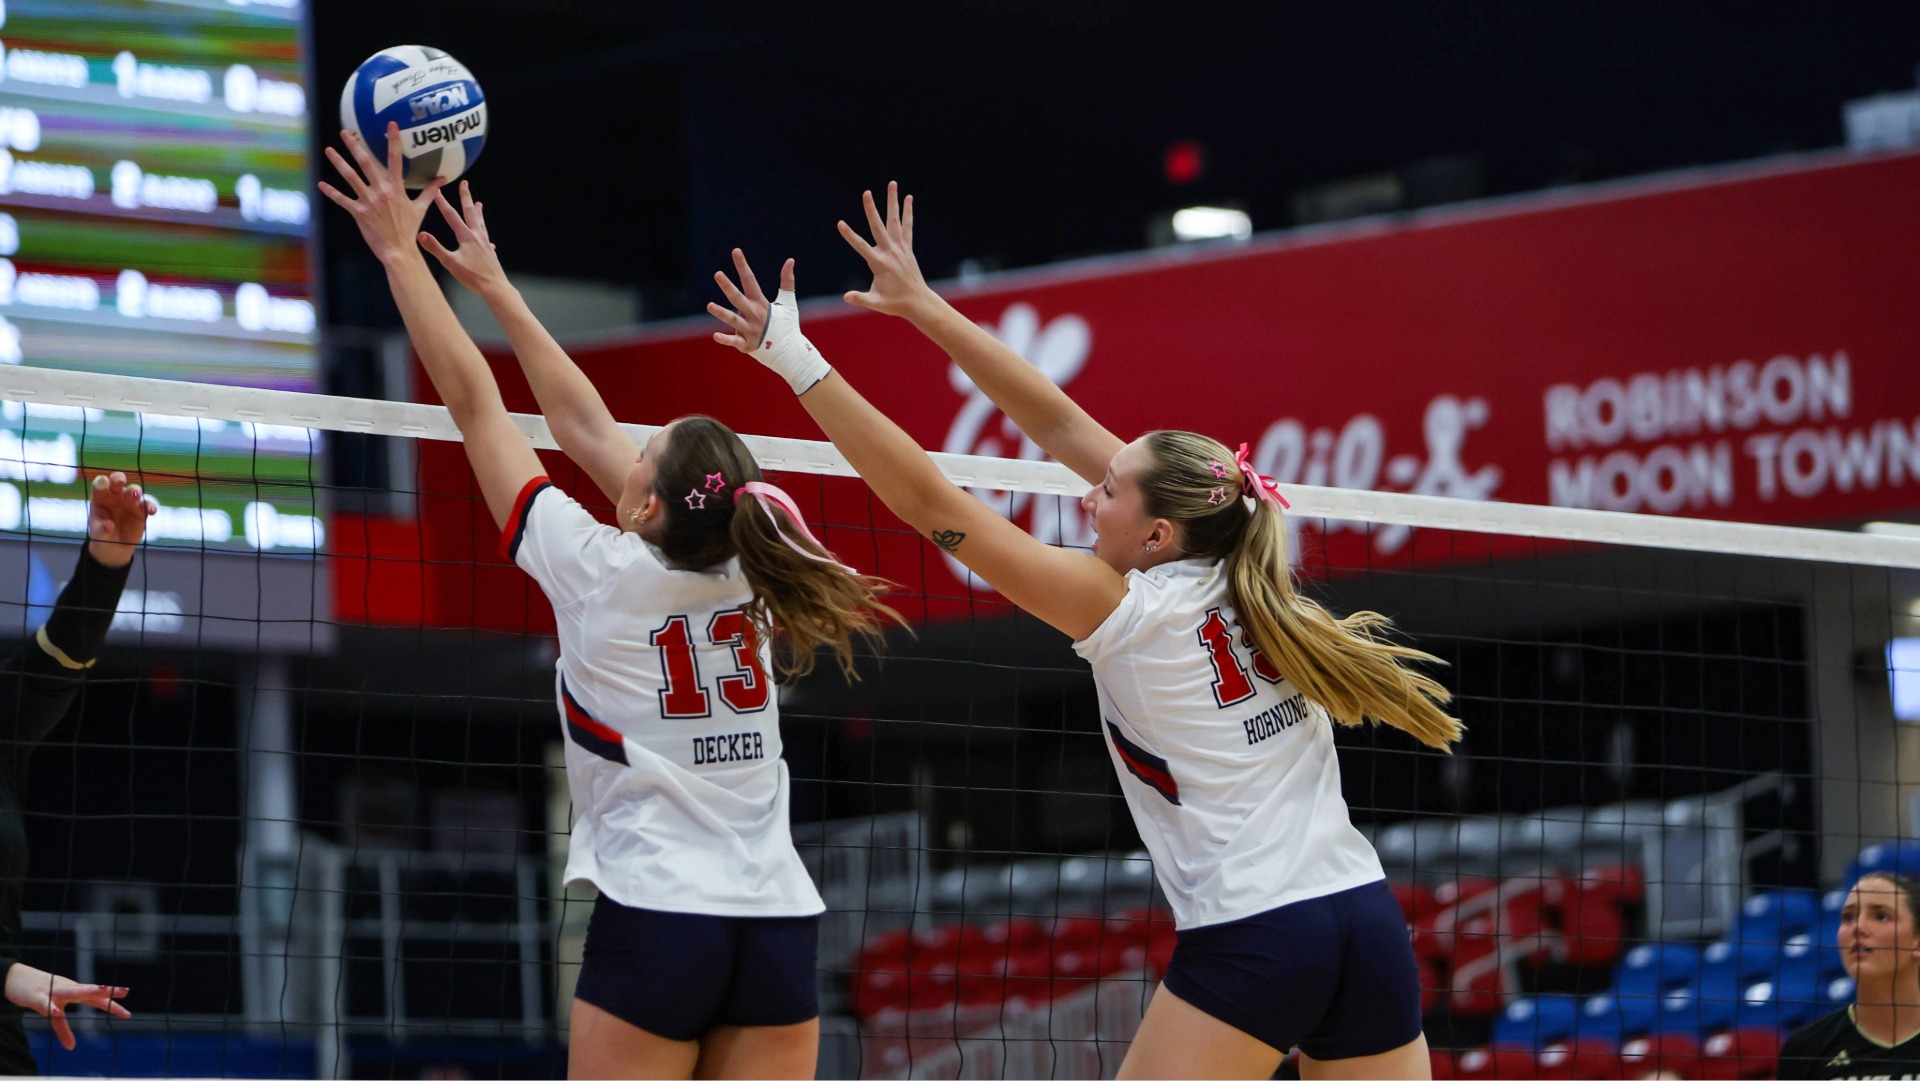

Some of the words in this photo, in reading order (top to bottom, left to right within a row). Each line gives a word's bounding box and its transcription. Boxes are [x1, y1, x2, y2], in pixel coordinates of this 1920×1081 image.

[408, 82, 469, 121] NCAA
[414, 111, 481, 145] molten
[1544, 349, 1851, 451] ROBINSON
[1548, 440, 1733, 512] MOON
[650, 609, 769, 719] 13
[1243, 693, 1308, 745] HORNUNG
[692, 731, 764, 765] DECKER
